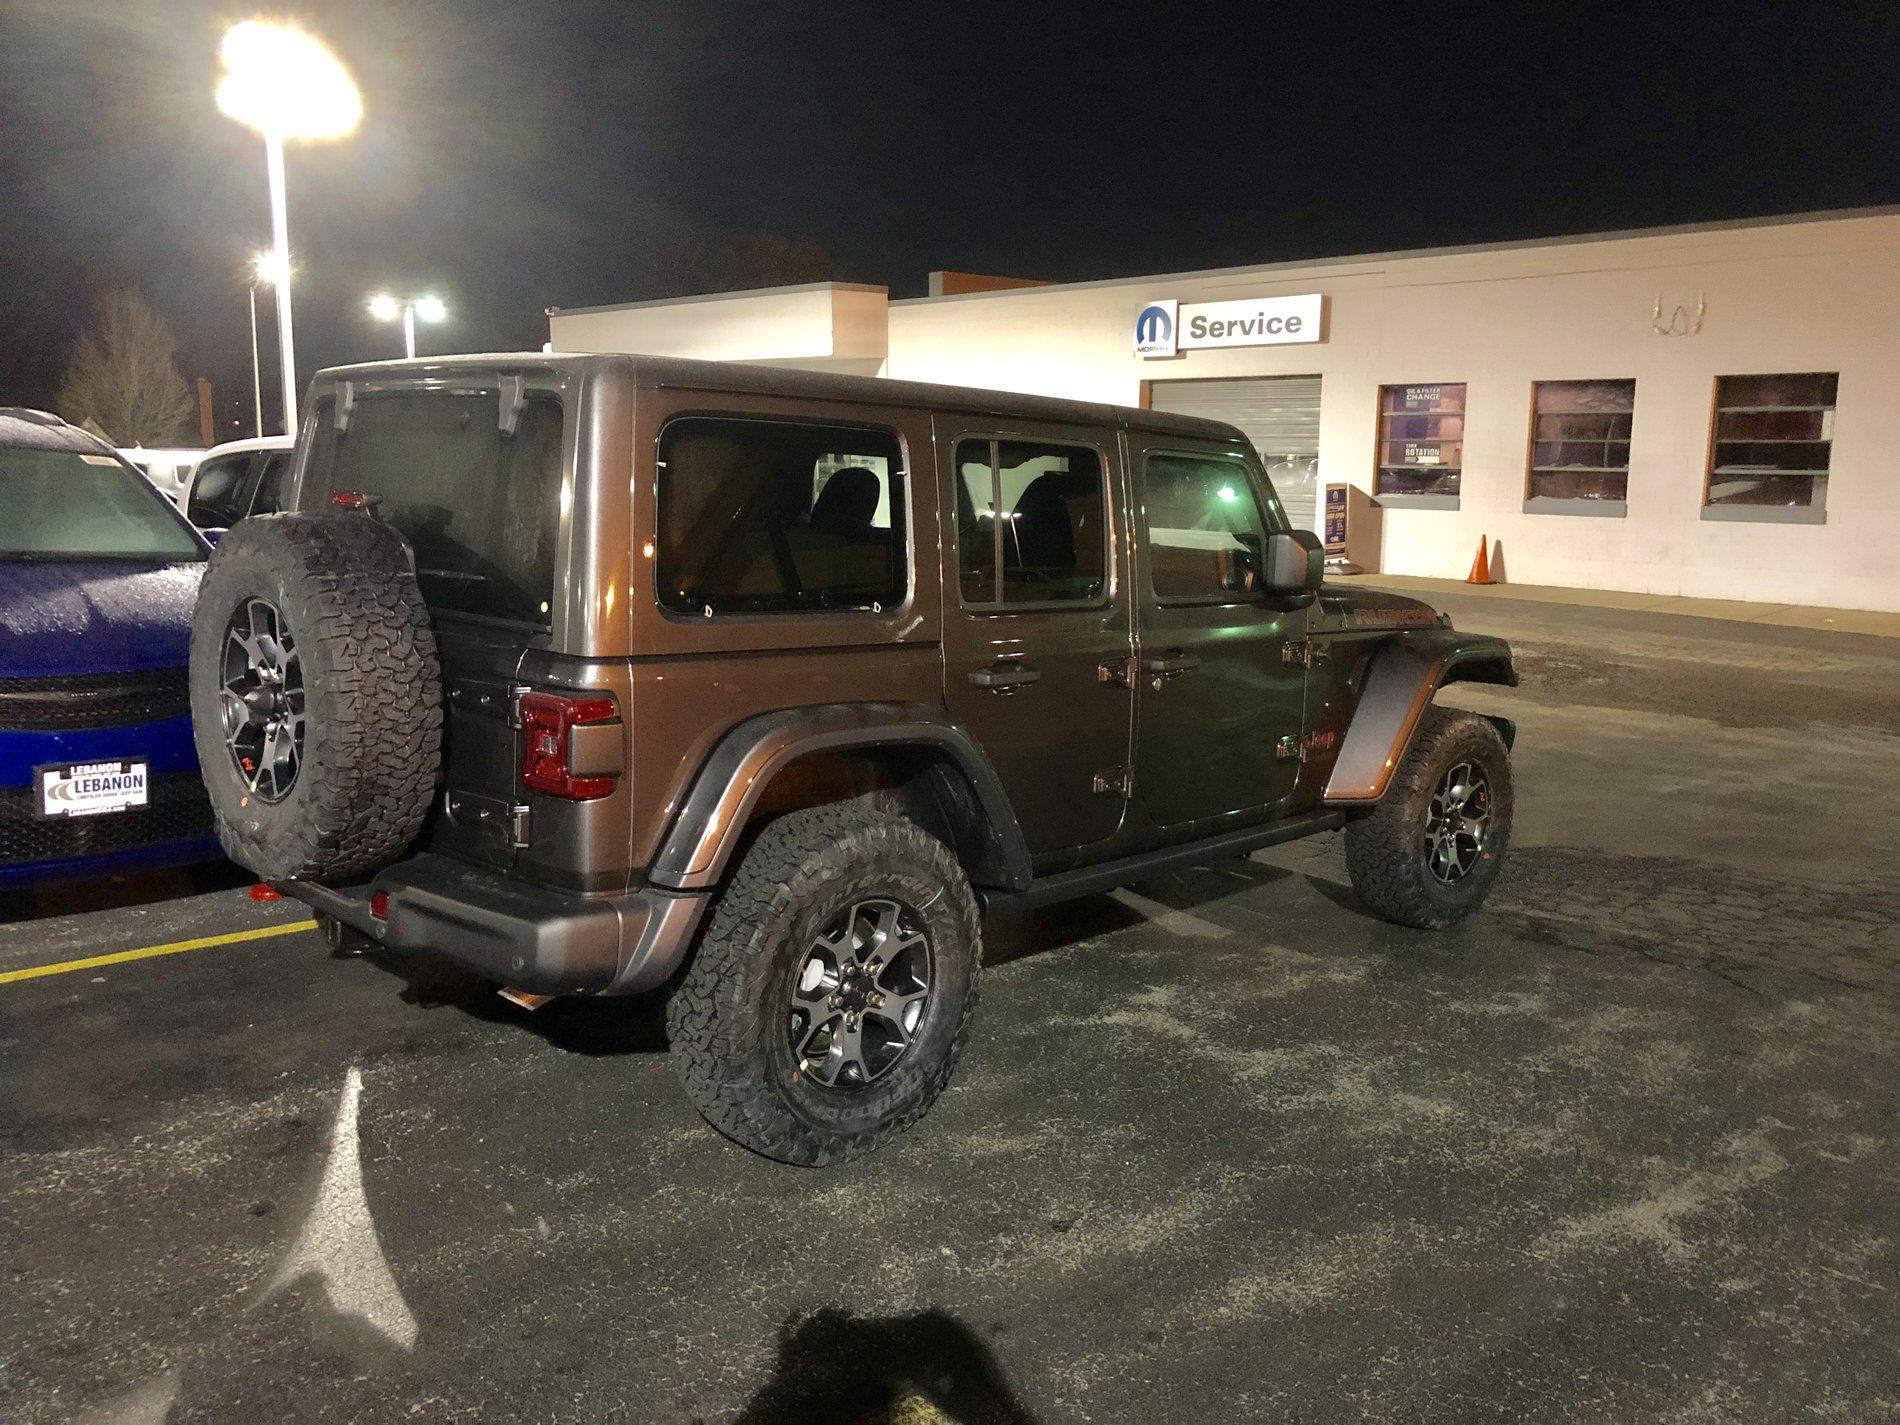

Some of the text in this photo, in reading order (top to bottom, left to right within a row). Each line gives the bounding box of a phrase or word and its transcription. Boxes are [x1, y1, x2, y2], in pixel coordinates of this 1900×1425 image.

[1190, 312, 1302, 339] Service
[1405, 448, 1440, 456] ROTATION
[70, 762, 122, 775] LEBANON
[74, 774, 143, 793] LEBANON
